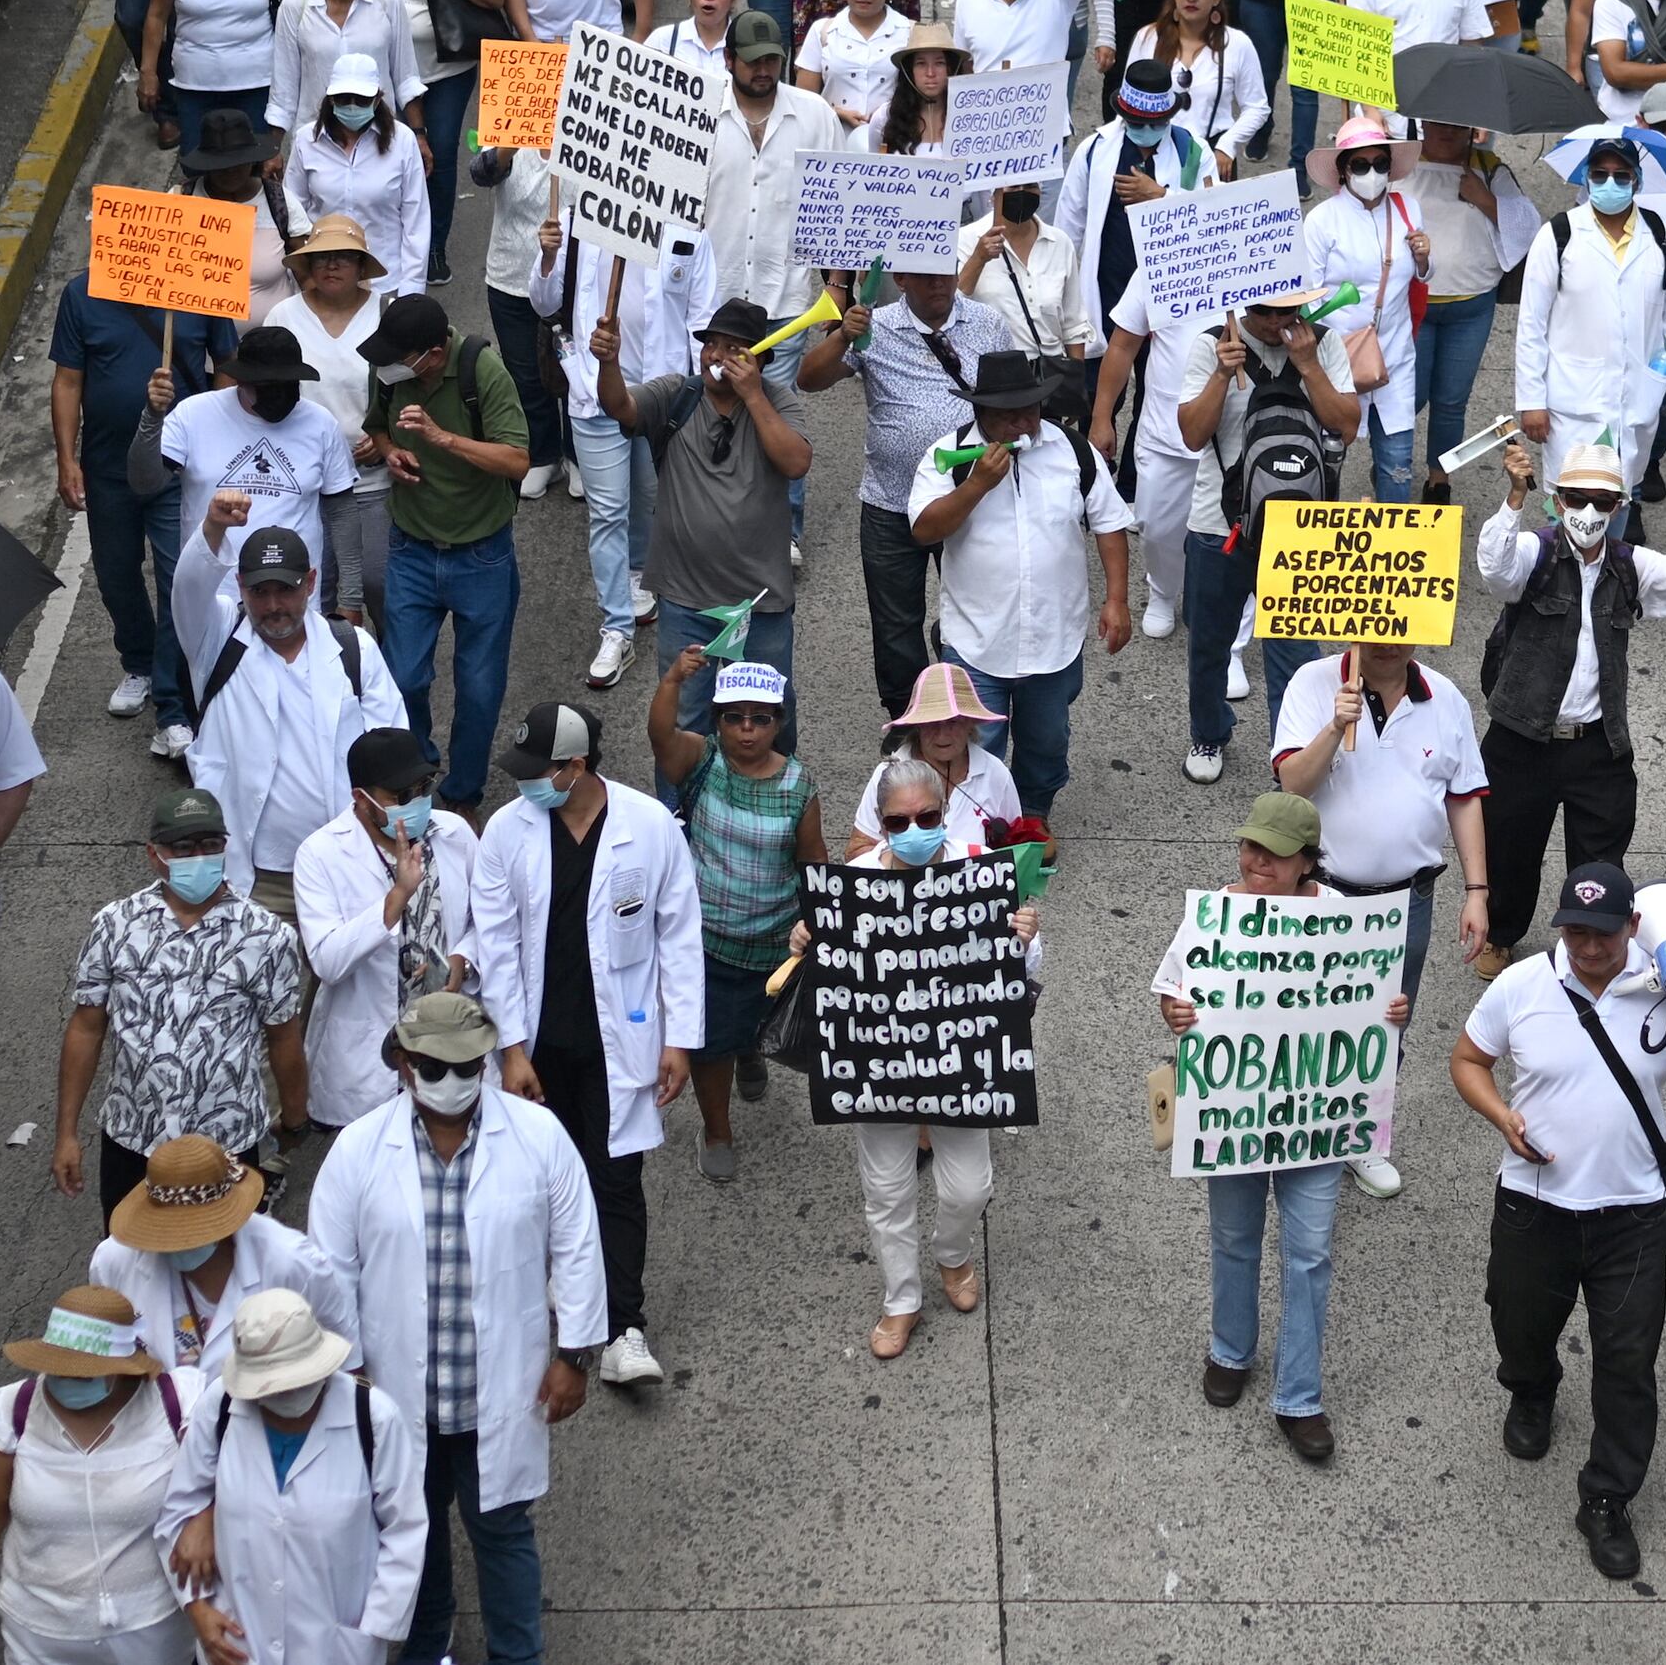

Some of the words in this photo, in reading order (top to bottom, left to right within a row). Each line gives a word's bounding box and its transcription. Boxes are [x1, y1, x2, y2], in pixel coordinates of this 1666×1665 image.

[1290, 3, 1324, 22] NUNCA
[1327, 14, 1337, 27] ES
[1340, 17, 1393, 45] DEMASIADO
[1291, 18, 1320, 34] TARDE
[1327, 29, 1353, 44] PARA
[1357, 38, 1391, 59] LUCHAR
[581, 30, 610, 63] YO
[616, 45, 704, 101] QUIERO
[1292, 59, 1313, 69] VIDA
[1293, 31, 1308, 44] POR
[1314, 37, 1352, 56] AQUELLO
[1357, 50, 1373, 63] QUE
[1376, 57, 1387, 69] ES
[483, 78, 501, 90] DE
[508, 81, 546, 95] CADA
[501, 67, 525, 79] LOS
[1357, 63, 1369, 75] EN
[1375, 70, 1387, 82] TU
[482, 95, 498, 106] ES
[505, 95, 523, 107] DE
[573, 60, 603, 92] MI
[608, 75, 717, 135] ESCALAFÓN
[1336, 80, 1393, 105] ESCALAFON
[520, 121, 537, 133] AL
[567, 88, 592, 115] NO
[595, 101, 624, 130] ME
[623, 114, 646, 140] LO
[649, 126, 709, 166] ROBEN
[951, 104, 1047, 133] ESCALAFON
[561, 116, 610, 151] COMO
[620, 140, 652, 171] ME
[951, 129, 1044, 157] ESCALAFON
[559, 143, 665, 208] ROBARON
[670, 189, 702, 224] MI
[803, 176, 836, 190] VALE
[865, 182, 917, 195] VALDRA
[805, 158, 826, 172] TU
[832, 163, 910, 180] ESFUERZO
[918, 169, 963, 186] VALIO,
[798, 203, 845, 215] NUNCA
[852, 205, 902, 218] PARES
[801, 189, 840, 201] PENA
[199, 214, 232, 234] UNA
[579, 190, 662, 249] COLÓN
[797, 216, 844, 226] NUNCA
[873, 218, 957, 232] CONFORMES
[1141, 203, 1197, 227] LUCHAR
[1143, 233, 1190, 251] TENDRA
[1197, 218, 1248, 239] SIEMPRE
[1252, 208, 1301, 228] GRANDES
[1150, 223, 1173, 237] POR
[1181, 217, 1198, 230] LA
[1203, 199, 1270, 223] JUSTICIA
[118, 222, 207, 248] INJUSTICIA
[844, 240, 887, 250] MEJOR
[898, 242, 925, 253] SEA
[845, 228, 870, 240] QUE
[898, 231, 947, 243] BUENO
[1145, 240, 1236, 267] RESISTENCIAS,
[1244, 225, 1295, 247] PORQUE
[94, 249, 103, 261] A
[107, 253, 151, 270] TODAS
[165, 262, 194, 277] LAS
[202, 268, 233, 284] QUE
[96, 235, 113, 248] ES
[119, 238, 161, 257] ABRIR
[168, 247, 183, 261] EL
[190, 249, 243, 271] CAMINO
[1148, 268, 1163, 280] LA
[1168, 251, 1237, 276] INJUSTICIA
[1249, 243, 1267, 258] ES
[1273, 242, 1292, 253] UN
[1150, 276, 1203, 294] NEGOCIO
[1208, 259, 1277, 282] BASTANTE
[168, 291, 246, 314] ESCALAFON
[1170, 303, 1190, 319] SI
[1196, 297, 1216, 312] AL
[1221, 275, 1302, 307] ESCALAFON
[225, 444, 253, 471] UNIDAD
[275, 447, 296, 474] LUCHA
[1273, 461, 1301, 473] PUMA
[1335, 531, 1372, 553] NO
[1272, 550, 1427, 573] ASEPTAMOS
[1292, 575, 1455, 602] PORCENTAJES
[1270, 616, 1408, 637] ESCALAFON
[732, 666, 782, 681] DEFIENDO
[805, 864, 844, 897] No
[854, 876, 905, 912] soy
[814, 898, 843, 930] ni
[1196, 893, 1231, 936] El
[1238, 897, 1354, 938] dinero
[1363, 907, 1403, 933] no
[816, 942, 865, 982] soy
[874, 930, 1025, 982] panadero
[1185, 938, 1317, 973] alcanza
[815, 985, 891, 1017] pero
[895, 968, 1026, 1013] defiendo
[1189, 986, 1226, 1010] se
[1235, 978, 1266, 1010] lo
[1276, 973, 1375, 1009] están
[819, 1019, 836, 1051] y
[847, 1013, 931, 1046] lucho
[936, 1014, 999, 1051] por
[820, 1050, 856, 1080] la
[867, 1043, 962, 1081] salud
[974, 1048, 992, 1081] y
[1001, 1035, 1034, 1072] la
[1176, 1024, 1389, 1100] ROBANDO
[831, 1080, 1016, 1118] educación
[1198, 1091, 1369, 1133] malditos
[1192, 1120, 1378, 1171] LADRONES
